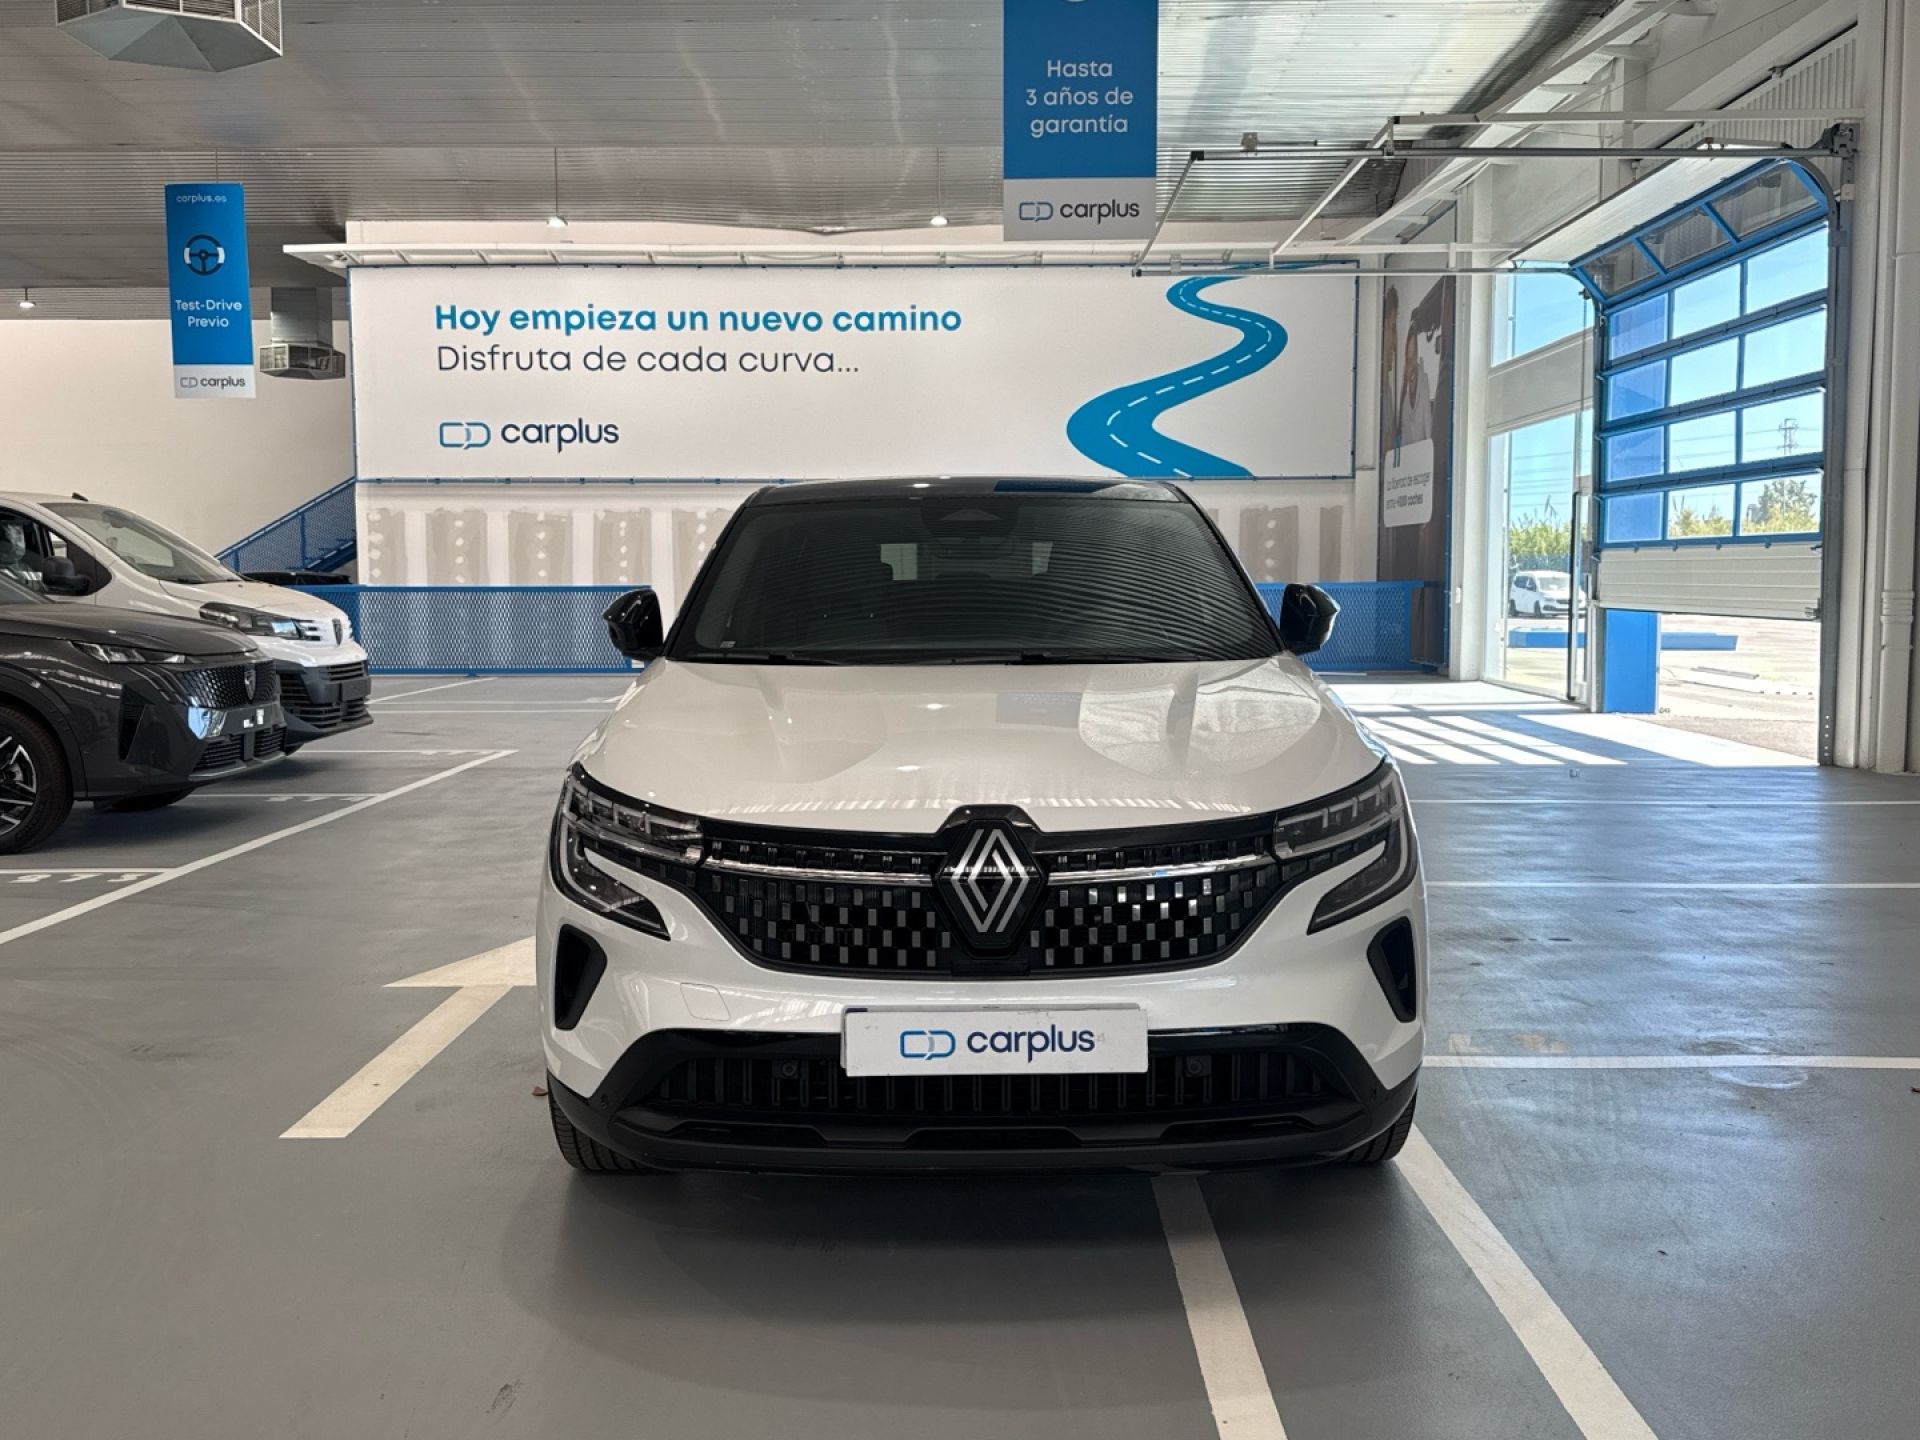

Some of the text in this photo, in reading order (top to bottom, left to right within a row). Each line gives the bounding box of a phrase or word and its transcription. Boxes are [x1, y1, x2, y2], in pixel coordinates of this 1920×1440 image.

[1047, 60, 1112, 78] Hasta
[1025, 87, 1134, 106] 3 años de
[1030, 114, 1128, 138] garantía
[176, 193, 228, 204] carplus.es
[1059, 200, 1140, 224] carplus
[175, 299, 243, 312] Test-Drive
[187, 315, 230, 328] Previo
[435, 304, 962, 336] Hoy empieza un nuevo camino
[437, 343, 860, 373] Disfruta de cada curva...
[200, 376, 246, 390] carplus
[500, 417, 620, 454] carplus
[966, 1023, 1096, 1064] carplus
